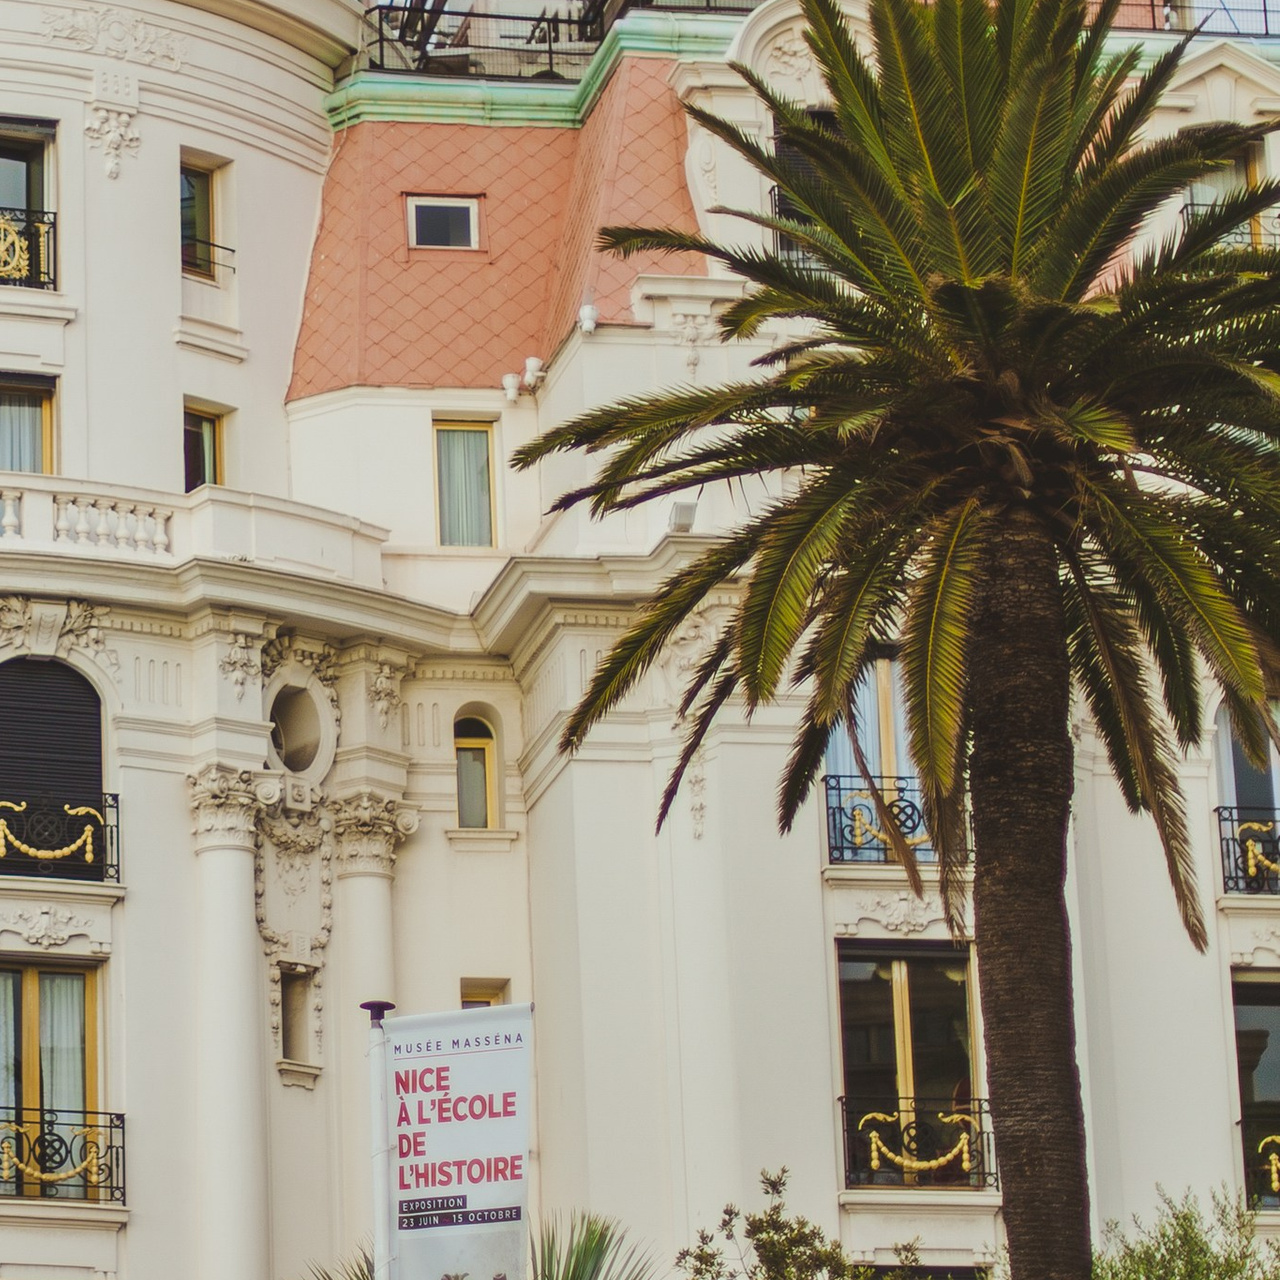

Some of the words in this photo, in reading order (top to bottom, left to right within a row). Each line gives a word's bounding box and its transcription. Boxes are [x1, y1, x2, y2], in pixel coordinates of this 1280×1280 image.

[394, 1039, 442, 1055] MUSÉE
[452, 1032, 523, 1050] MASSÉNA
[394, 1065, 450, 1096] NICE
[396, 1095, 412, 1127] À
[417, 1091, 517, 1125] L'ÉCOLE
[398, 1131, 427, 1159] DE
[398, 1154, 523, 1190] L'HISTOIRE
[402, 1197, 464, 1212] EXPOSITION
[402, 1218, 415, 1228] 23
[418, 1216, 440, 1227] JUIN
[452, 1214, 463, 1224] 15
[468, 1209, 517, 1222] OCTOBRE
